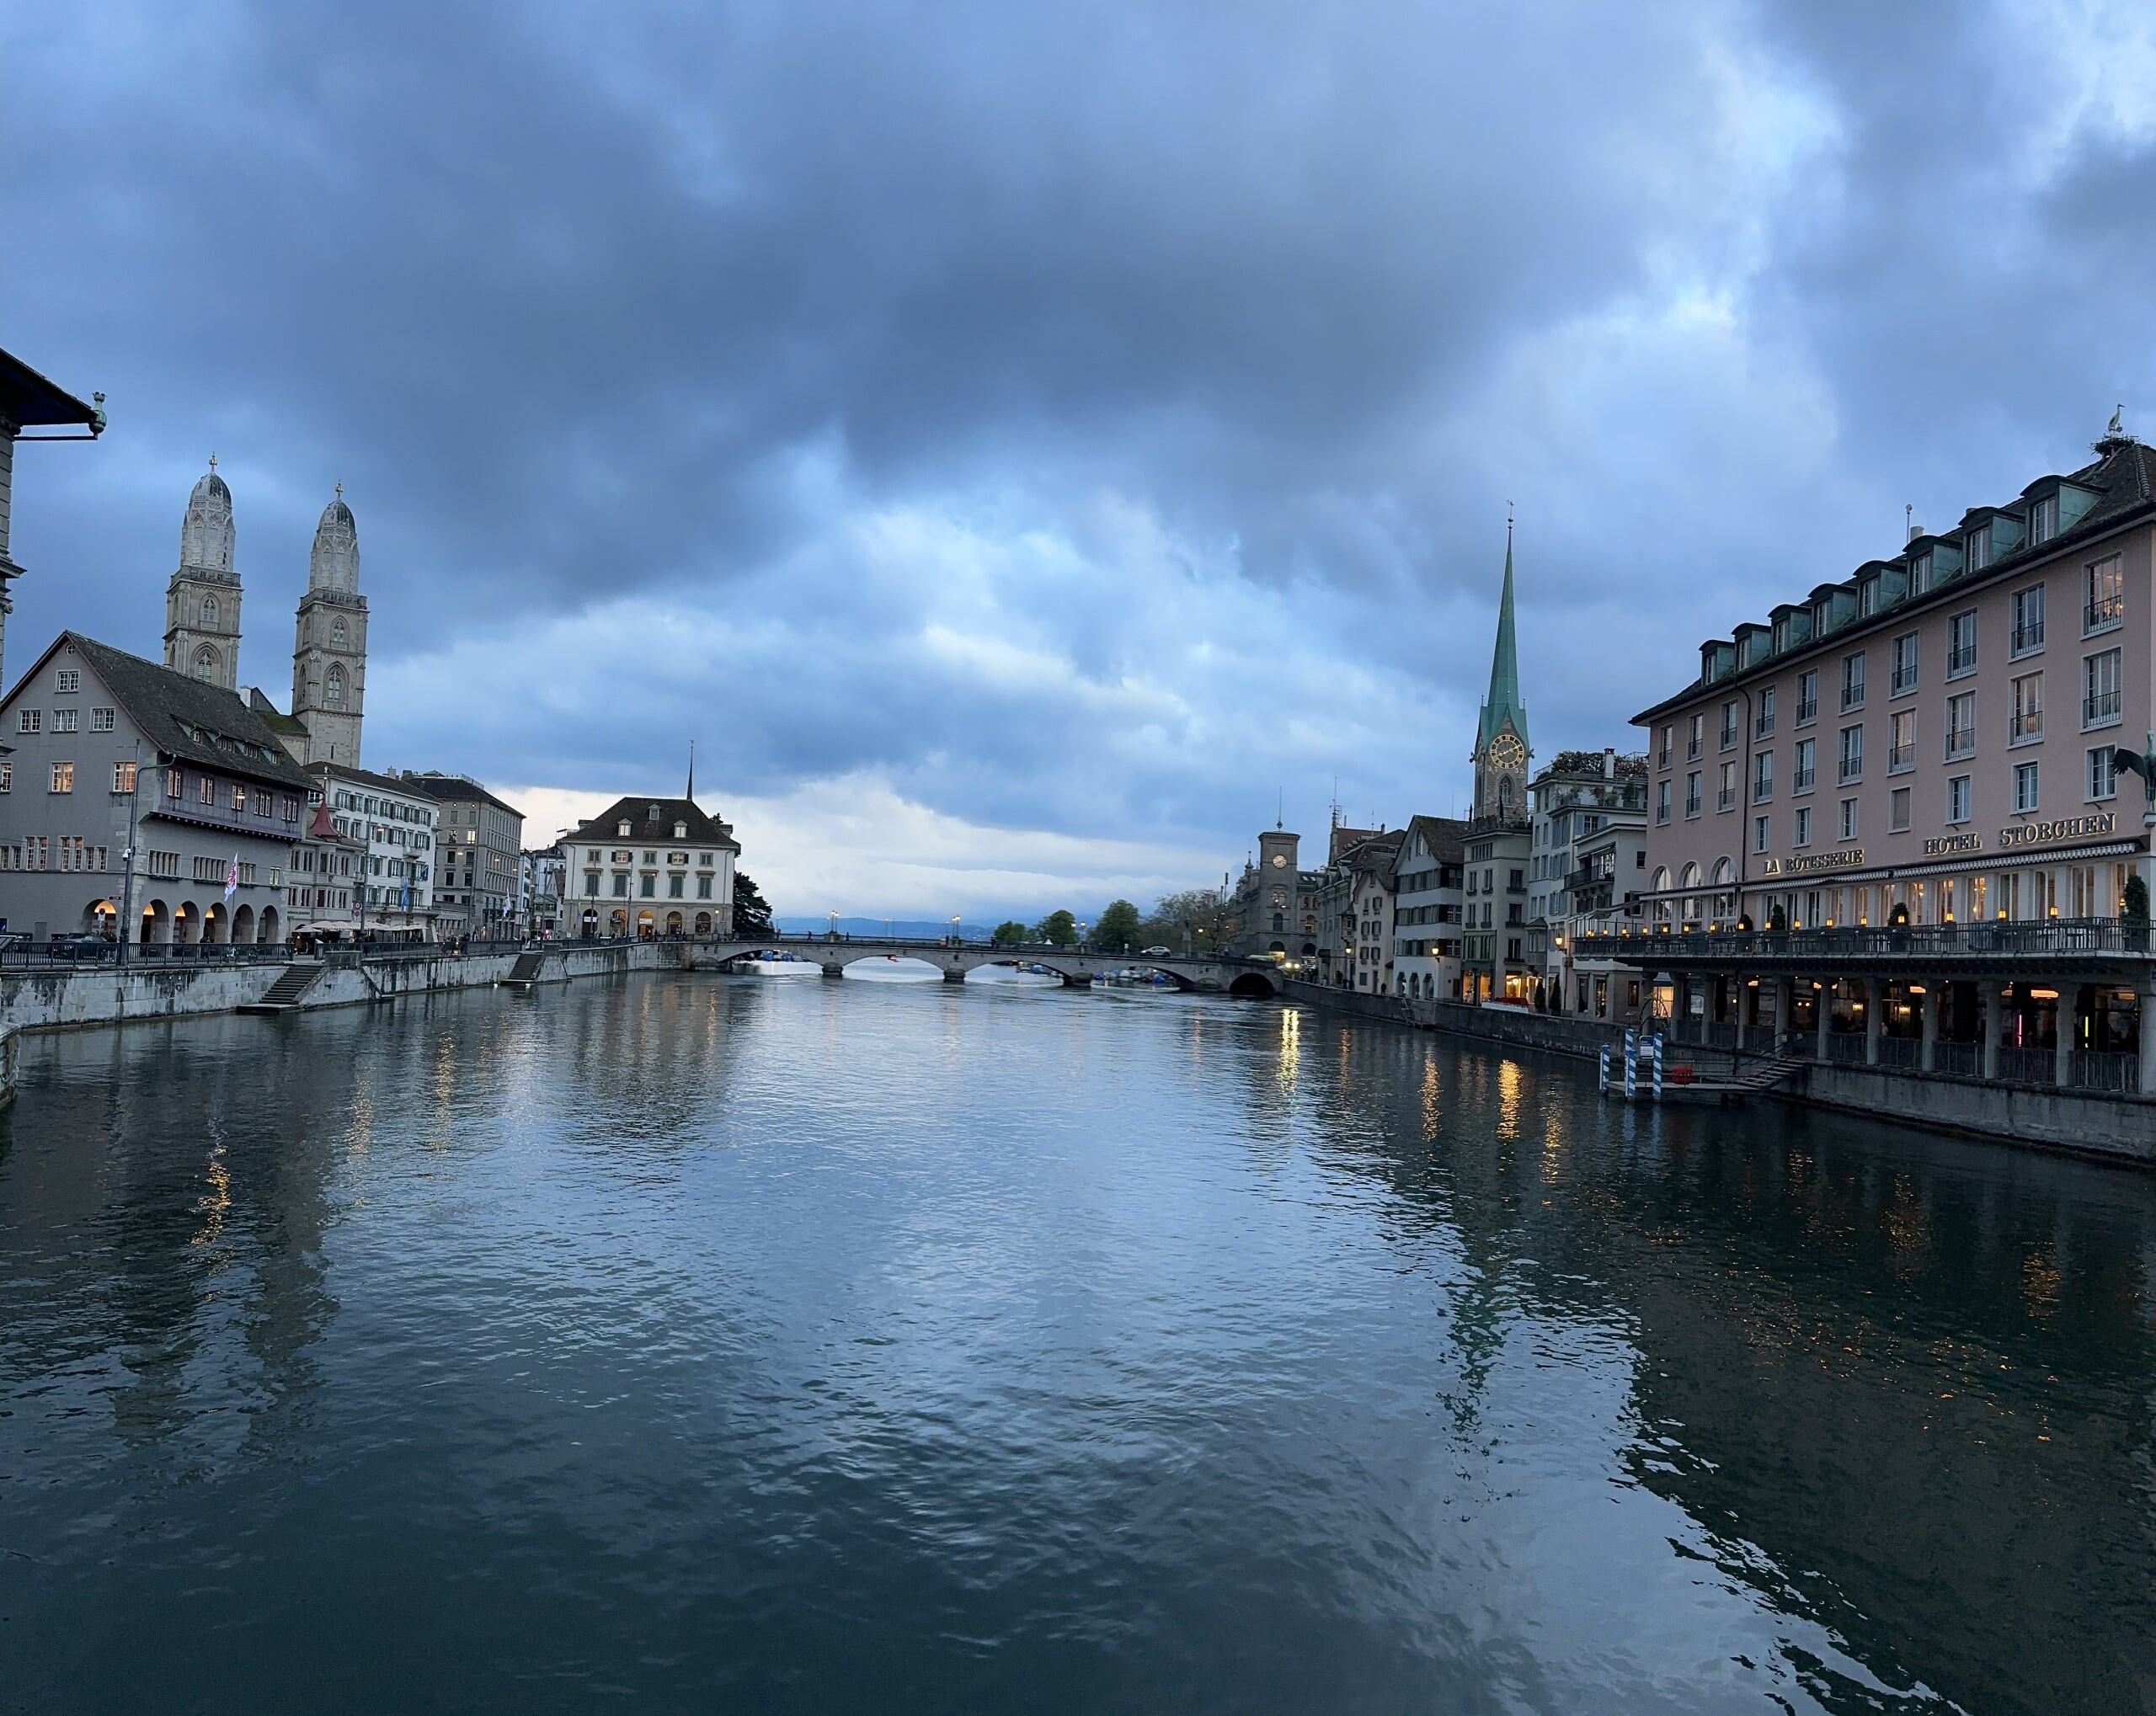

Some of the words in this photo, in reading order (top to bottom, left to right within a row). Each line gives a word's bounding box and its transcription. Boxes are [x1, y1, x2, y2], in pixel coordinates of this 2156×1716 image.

[1924, 833, 1983, 855] HOTEL
[1999, 813, 2116, 847] STORCHEN
[1764, 859, 1780, 875] LA
[1785, 849, 1865, 871] RÔTISSERIE
